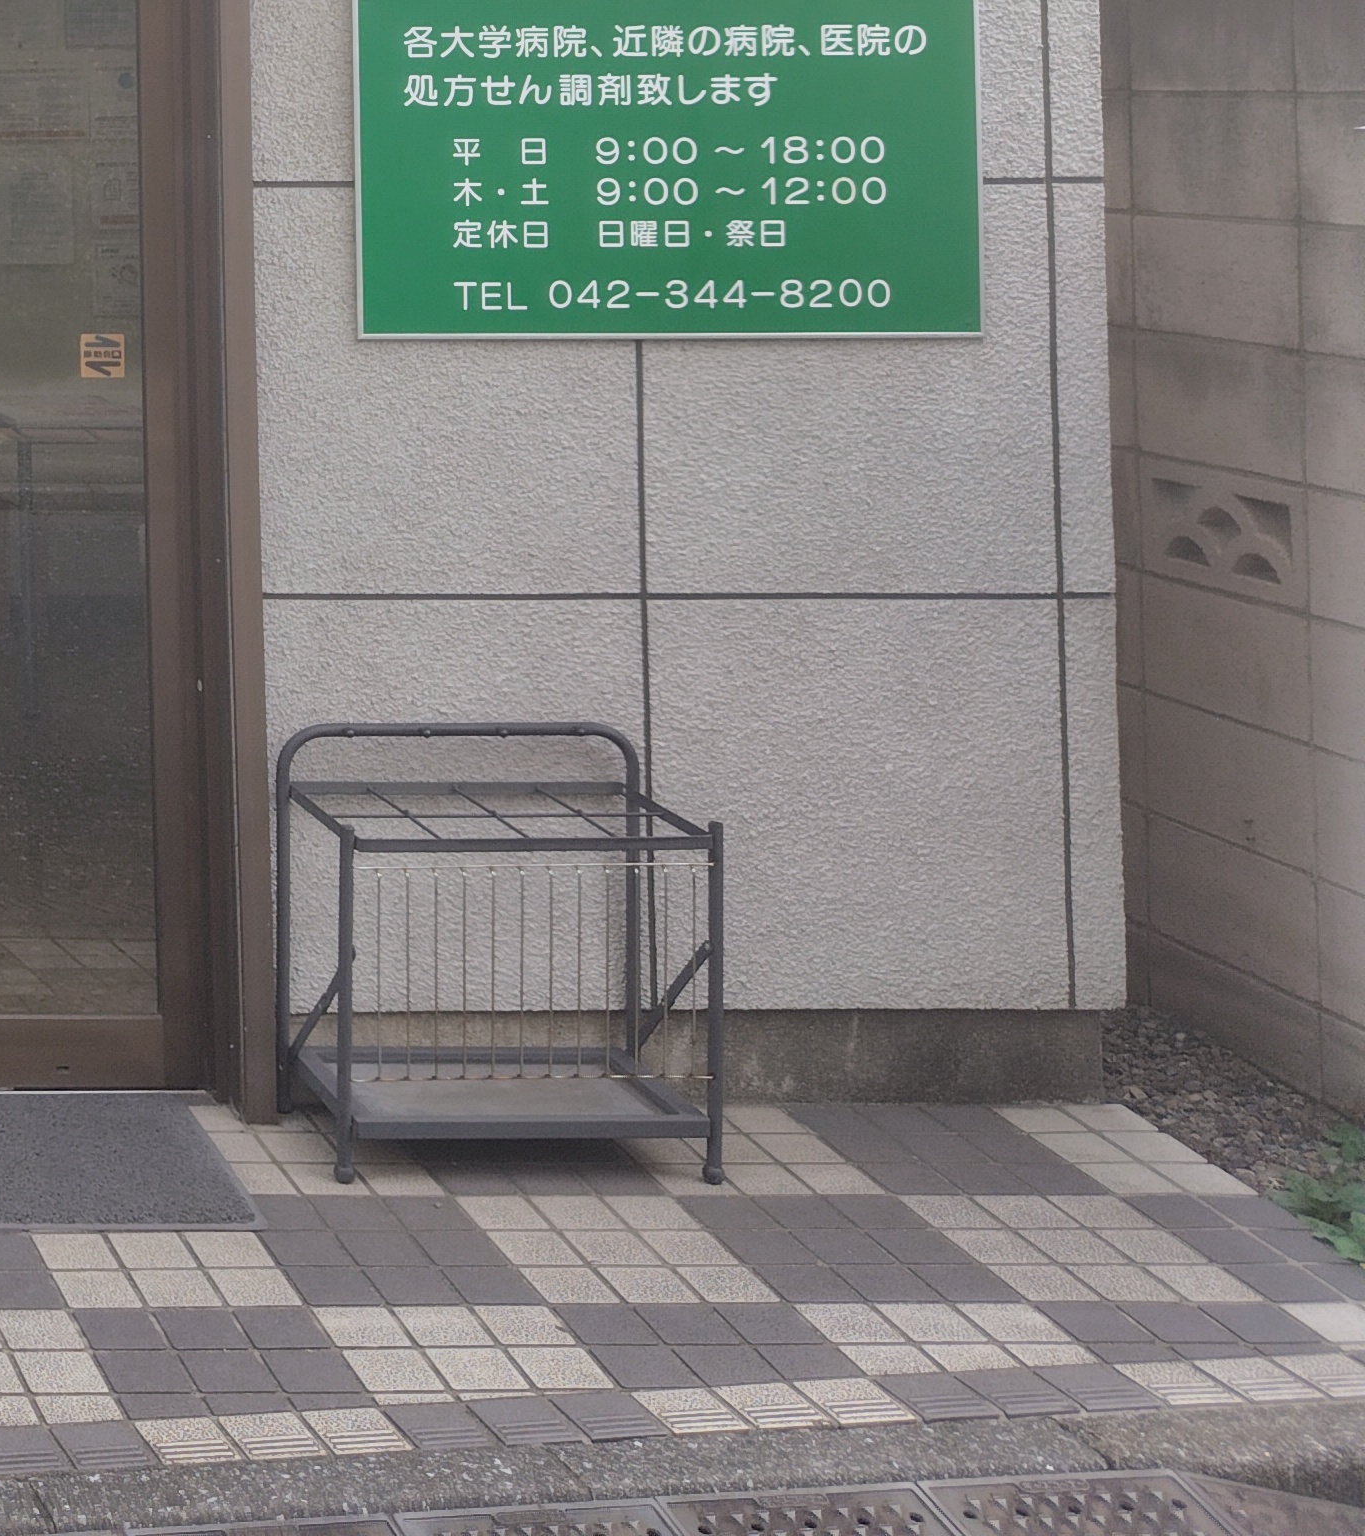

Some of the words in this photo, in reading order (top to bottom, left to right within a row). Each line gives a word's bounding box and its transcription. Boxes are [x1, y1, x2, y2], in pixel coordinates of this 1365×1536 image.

[403, 24, 928, 60] 各大学病院、近隣の病院、医院の
[403, 73, 778, 107] 処方せん調剤致します
[452, 220, 550, 249] 定休日
[598, 220, 787, 249] 日曜日・祭日
[453, 281, 528, 311] TEL
[548, 279, 892, 310] 042-344-8200
